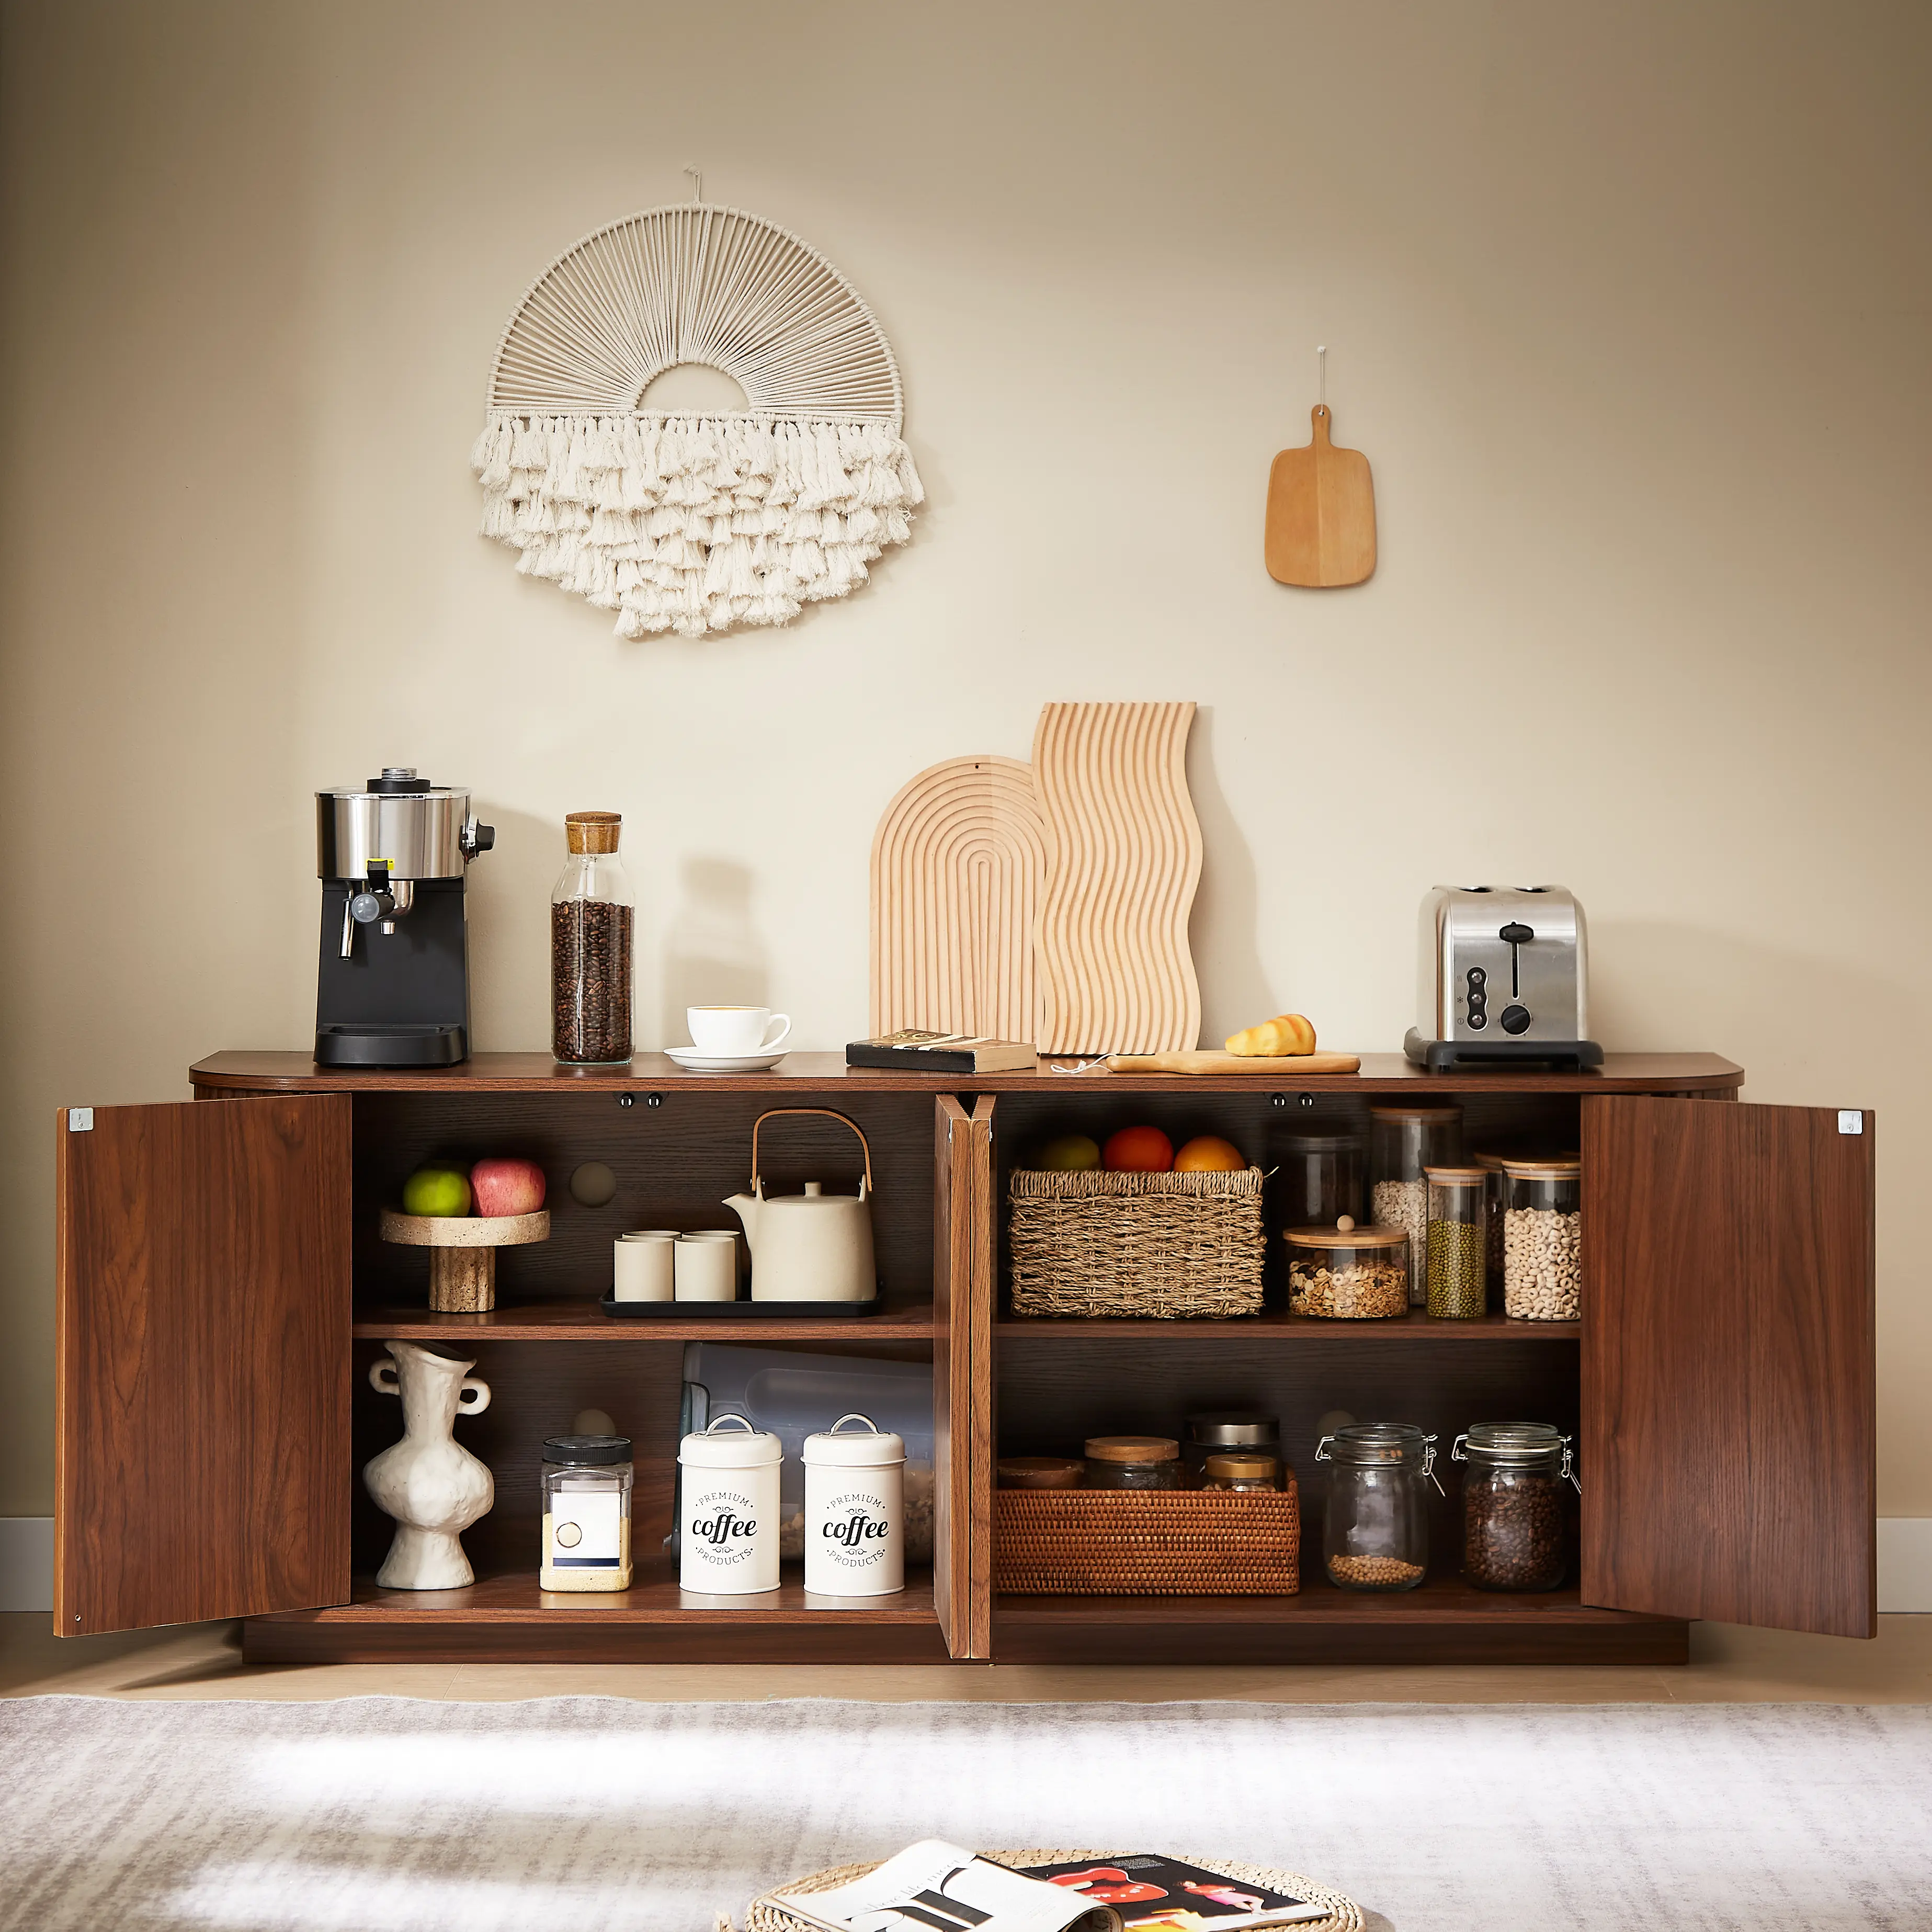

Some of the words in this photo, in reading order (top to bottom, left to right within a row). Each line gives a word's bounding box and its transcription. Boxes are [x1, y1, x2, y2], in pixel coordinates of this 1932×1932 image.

[698, 1492, 749, 1506] PREMIUM
[830, 1494, 882, 1508] PREMIUM
[692, 1514, 757, 1544] coffee
[823, 1516, 889, 1547] coffee
[697, 1548, 751, 1565] PRODUCTS
[829, 1550, 884, 1567] PRODUCTS
